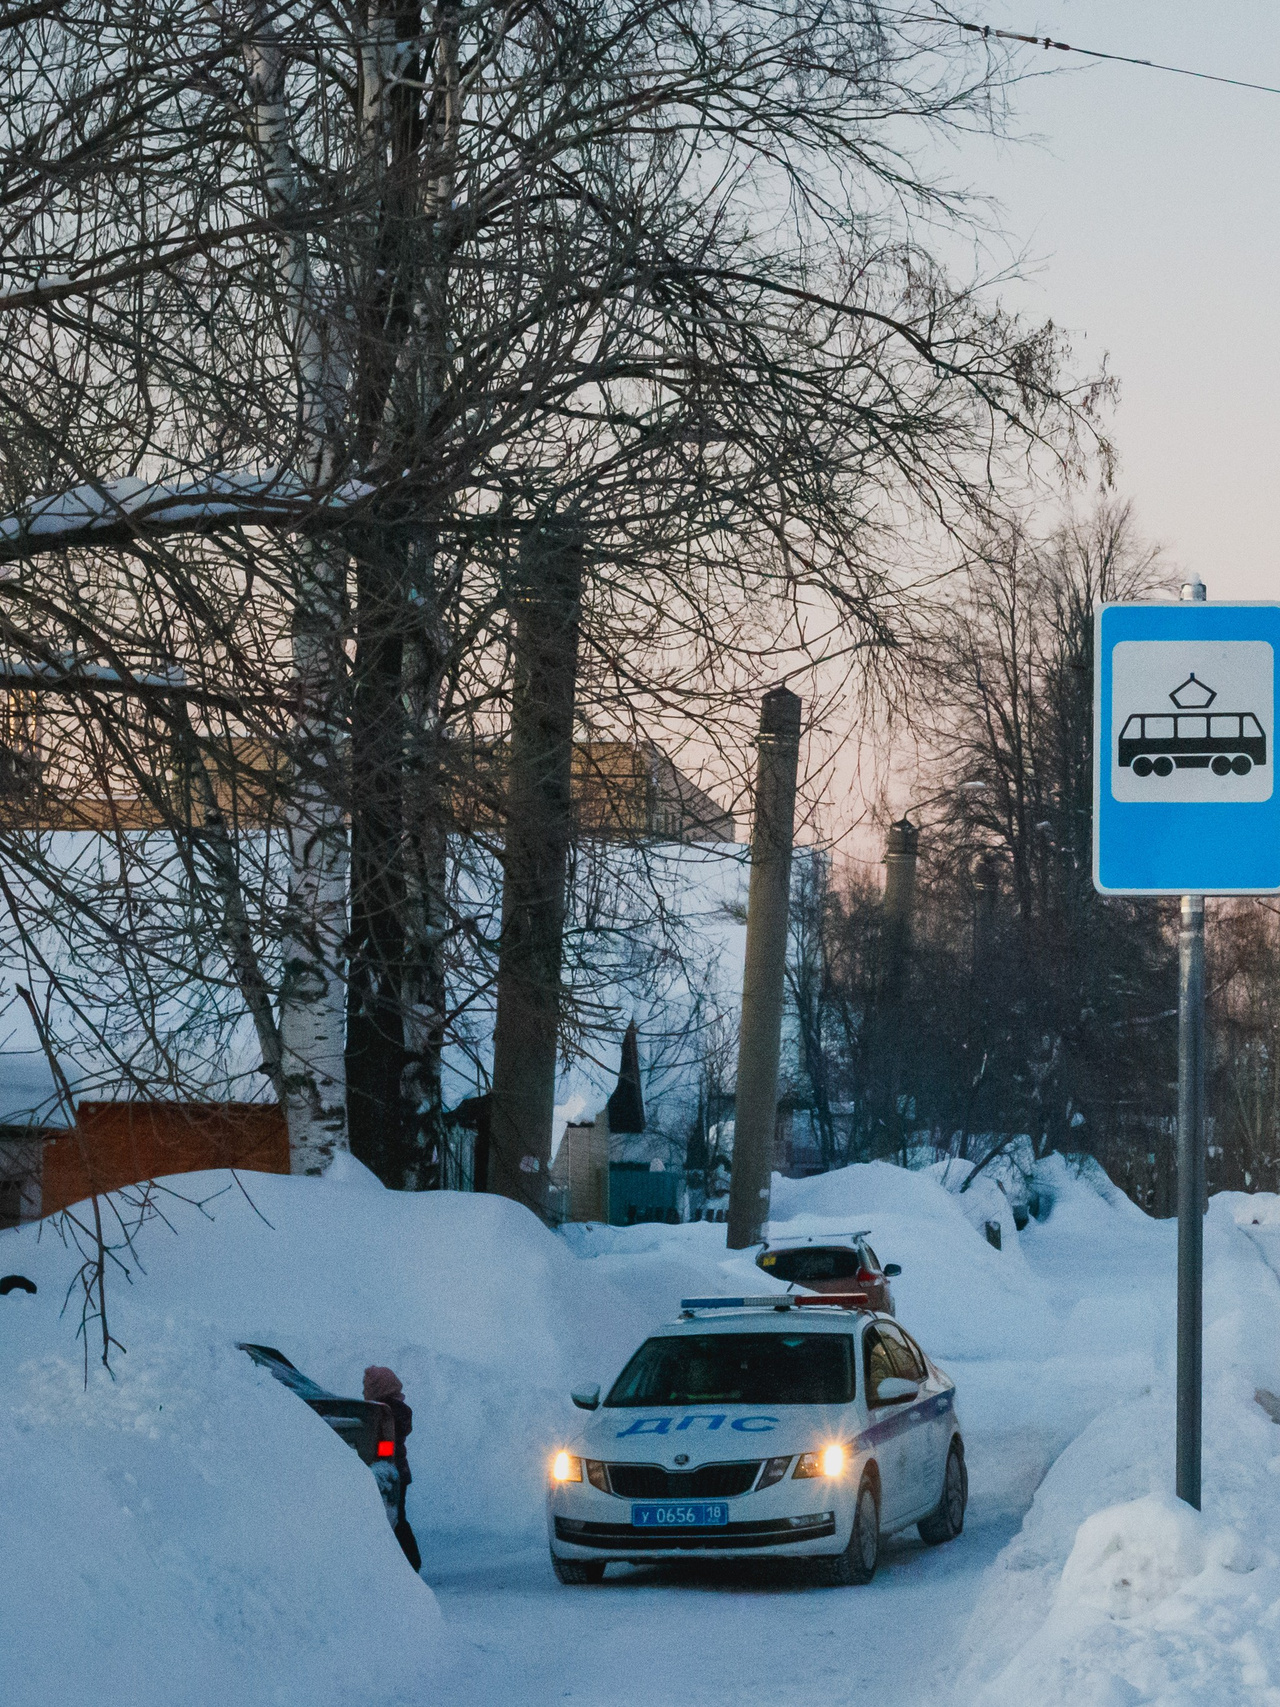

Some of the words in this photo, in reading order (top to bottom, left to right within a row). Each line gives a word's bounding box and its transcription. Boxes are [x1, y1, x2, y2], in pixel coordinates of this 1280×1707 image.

[616, 1414, 781, 1438] ДПС
[656, 1507, 696, 1523] 0656
[706, 1506, 721, 1518] 18
